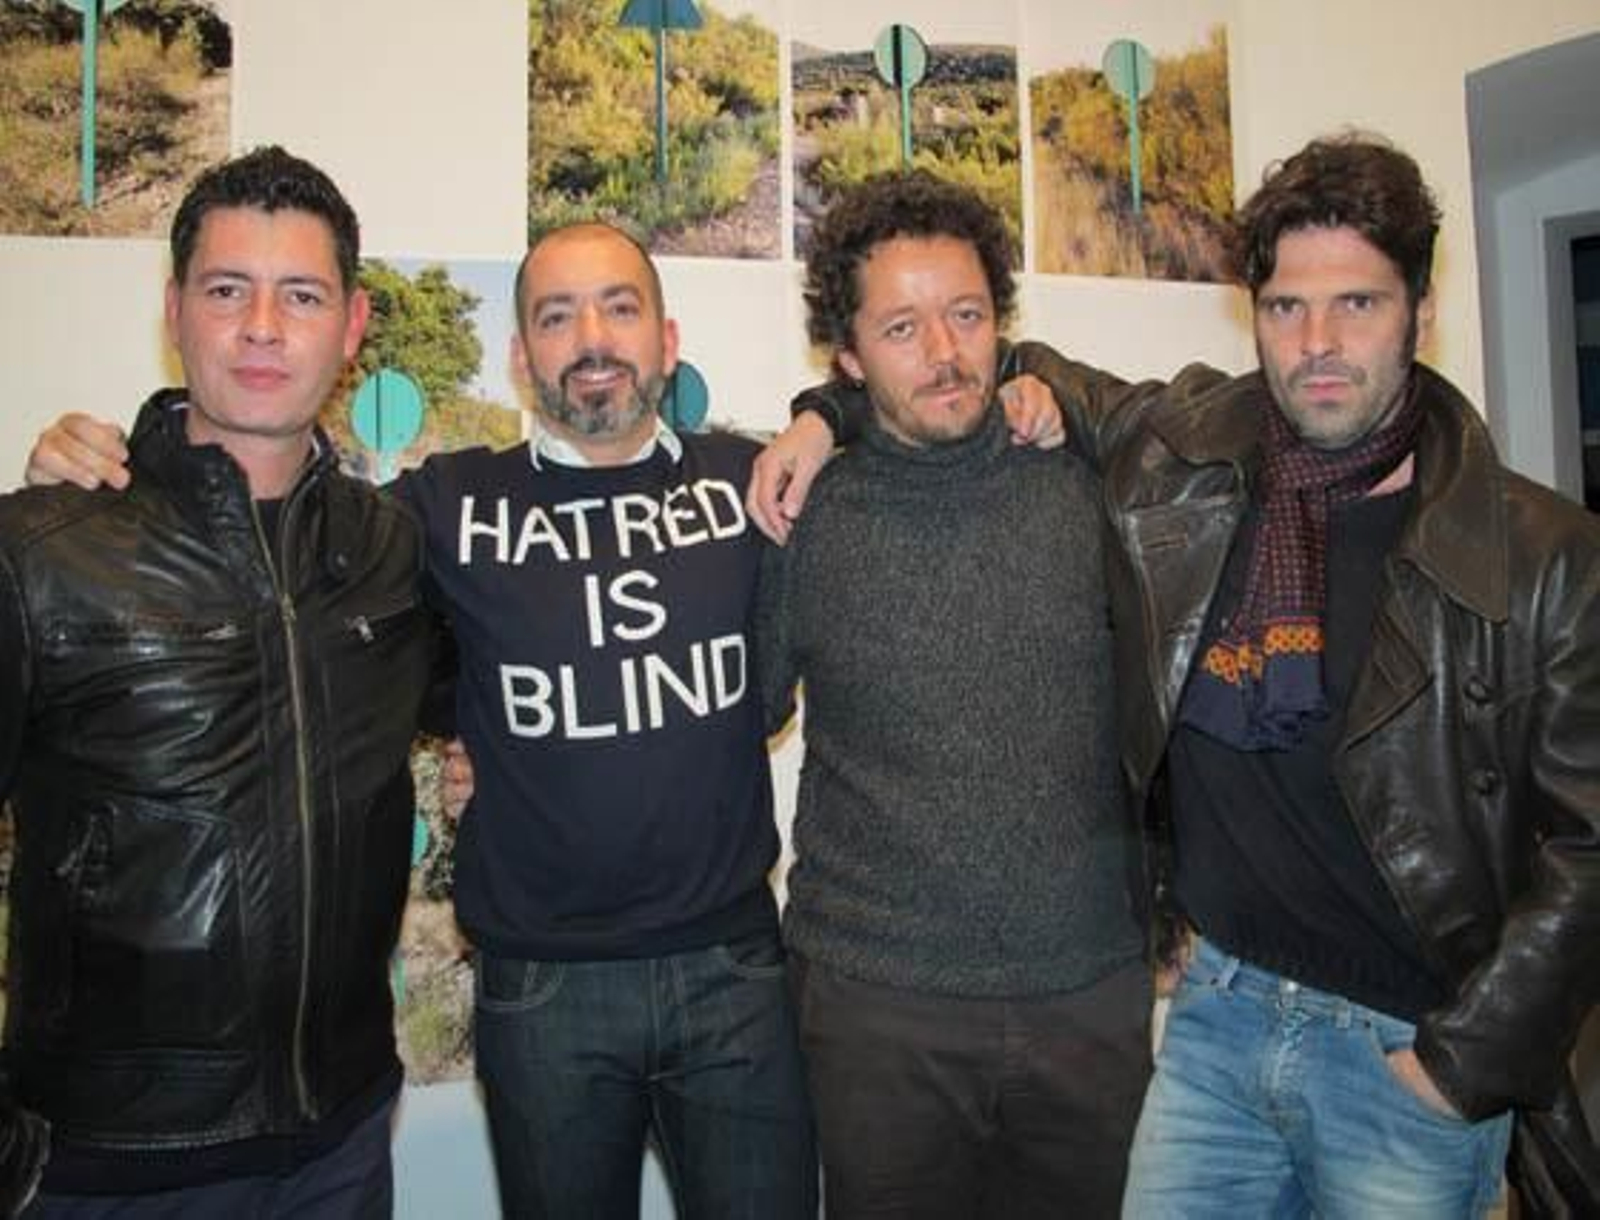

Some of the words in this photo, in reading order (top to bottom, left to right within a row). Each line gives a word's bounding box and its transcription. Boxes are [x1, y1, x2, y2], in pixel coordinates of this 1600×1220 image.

[458, 478, 747, 565] HATRED
[584, 569, 667, 648] IS
[499, 634, 747, 739] BLIND
